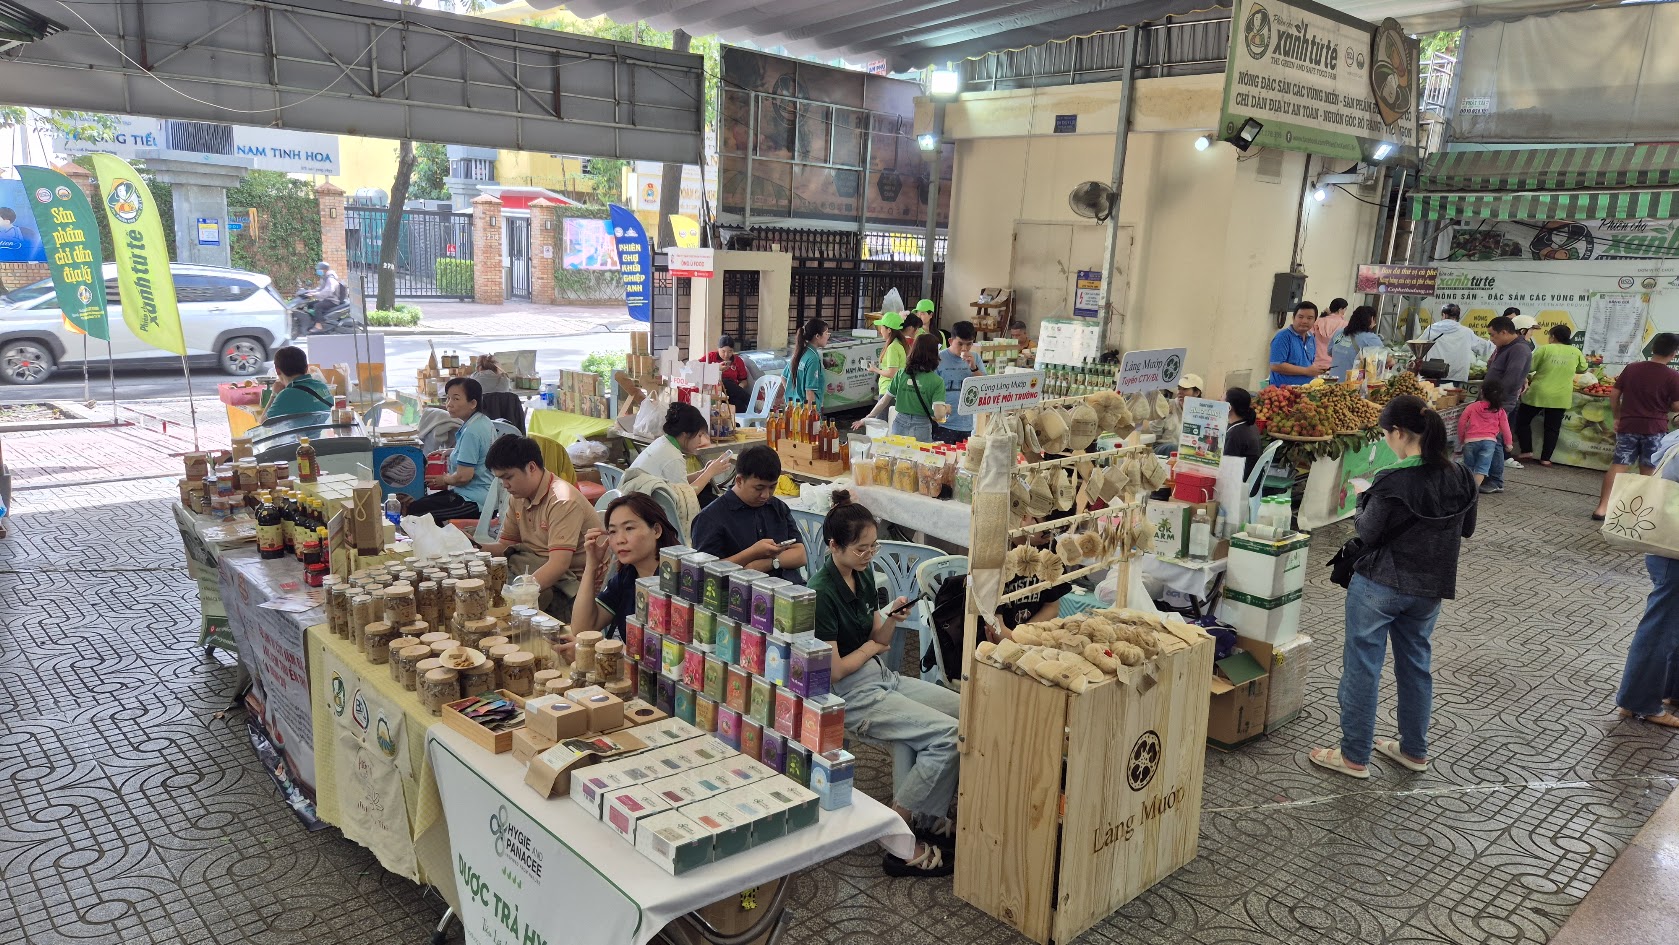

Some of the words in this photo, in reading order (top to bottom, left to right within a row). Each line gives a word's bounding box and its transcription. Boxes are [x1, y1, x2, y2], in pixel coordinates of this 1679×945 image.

[1272, 24, 1309, 62] xanh
[1325, 40, 1338, 71] tế
[1271, 57, 1280, 66] THE
[1280, 60, 1294, 69] GREEN
[1295, 63, 1305, 72] AND
[1305, 65, 1317, 75] SAFE
[1316, 69, 1328, 78] FOOD
[1328, 72, 1337, 80] FAIR
[1238, 70, 1259, 88] NÔNG
[1260, 75, 1276, 93] ĐẶC
[1277, 78, 1292, 94] SẢN
[1292, 81, 1306, 97] CÁC
[1306, 85, 1323, 102] VÙNG
[1324, 89, 1339, 105] MIỀN
[1343, 93, 1355, 109] SẢN
[1355, 96, 1372, 114] PHẨM
[1235, 90, 1249, 107] CHỈ
[1251, 92, 1267, 110] DẪN
[1268, 99, 1282, 115] ĐỊA
[1283, 99, 1291, 114] LÝ
[1291, 103, 1301, 116] AN
[1302, 104, 1319, 120] TOÀN
[1323, 109, 1344, 126] NGUỒN
[1344, 112, 1357, 128] GỐC
[1366, 118, 1381, 132] RÀNG
[236, 144, 267, 157] NAM
[271, 148, 301, 160] TINH
[305, 151, 332, 163] HOA
[51, 207, 76, 224] Sản
[1598, 218, 1628, 231] Phiên
[1629, 219, 1648, 233] chợ
[52, 225, 85, 247] phẩm
[126, 230, 146, 251] tế
[55, 248, 73, 265] chỉ
[74, 245, 93, 262] dẫn
[619, 241, 641, 252] PHIÊN
[621, 262, 641, 272] KHỞI
[622, 253, 639, 263] CHỢ
[64, 266, 82, 284] địa
[82, 265, 92, 283] lý
[1437, 272, 1470, 287] xanh
[1483, 275, 1496, 287] tế
[134, 277, 159, 327] xanh
[1435, 292, 1457, 300] NÔNG
[1460, 291, 1477, 300] SẢN
[1508, 292, 1526, 302] SẢN
[1529, 292, 1547, 302] CÁC
[1550, 293, 1575, 302] VÙNG
[1125, 361, 1141, 373] Làng
[1142, 358, 1163, 371] Mướp
[978, 393, 991, 406] BẢO
[992, 393, 1001, 405] VỆ
[1001, 392, 1013, 403] MÔI
[1015, 390, 1039, 401] TRƯỜNG
[507, 822, 532, 852] HYGIE
[532, 846, 544, 862] AND
[1093, 814, 1136, 855] Làng
[506, 838, 542, 878] PANACEE
[459, 852, 489, 907] DƯỢC
[493, 891, 519, 941] TRÀ
